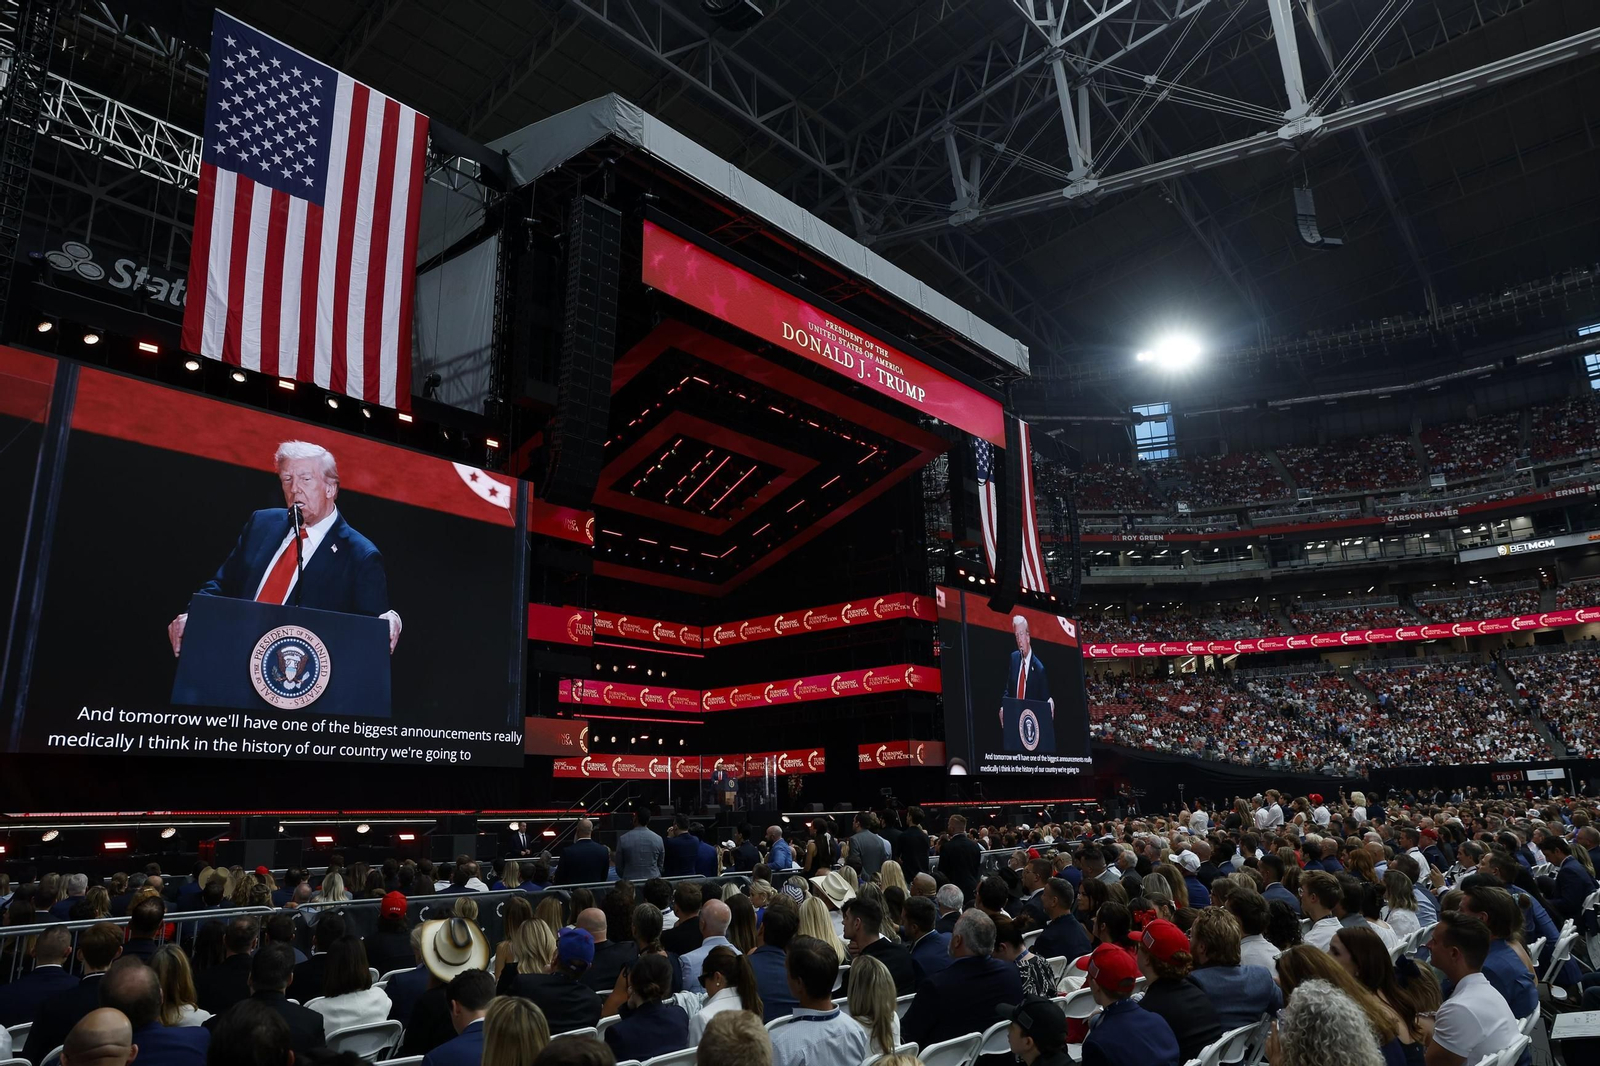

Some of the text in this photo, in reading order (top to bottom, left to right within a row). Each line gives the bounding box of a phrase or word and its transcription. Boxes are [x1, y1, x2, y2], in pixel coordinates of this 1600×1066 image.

[108, 259, 187, 307] Stat
[808, 322, 904, 375] UNITED STATES OF AMERICA
[826, 320, 888, 358] PRESIDENT OF THE
[782, 322, 925, 402] DONALD J. TRUMP
[1555, 487, 1586, 497] ERNIE
[1388, 513, 1422, 521] CARSON
[1424, 510, 1458, 518] PALMER
[1510, 539, 1554, 553] BETMGM
[254, 629, 294, 660] PRESIDENT
[315, 642, 327, 677] UNITED
[260, 684, 280, 703] SEAL
[294, 684, 322, 706] STATES
[77, 706, 522, 745] And tomorrow we'll have one of the biggest announcements really
[48, 732, 471, 762] medically I think in the history of our country we're going to
